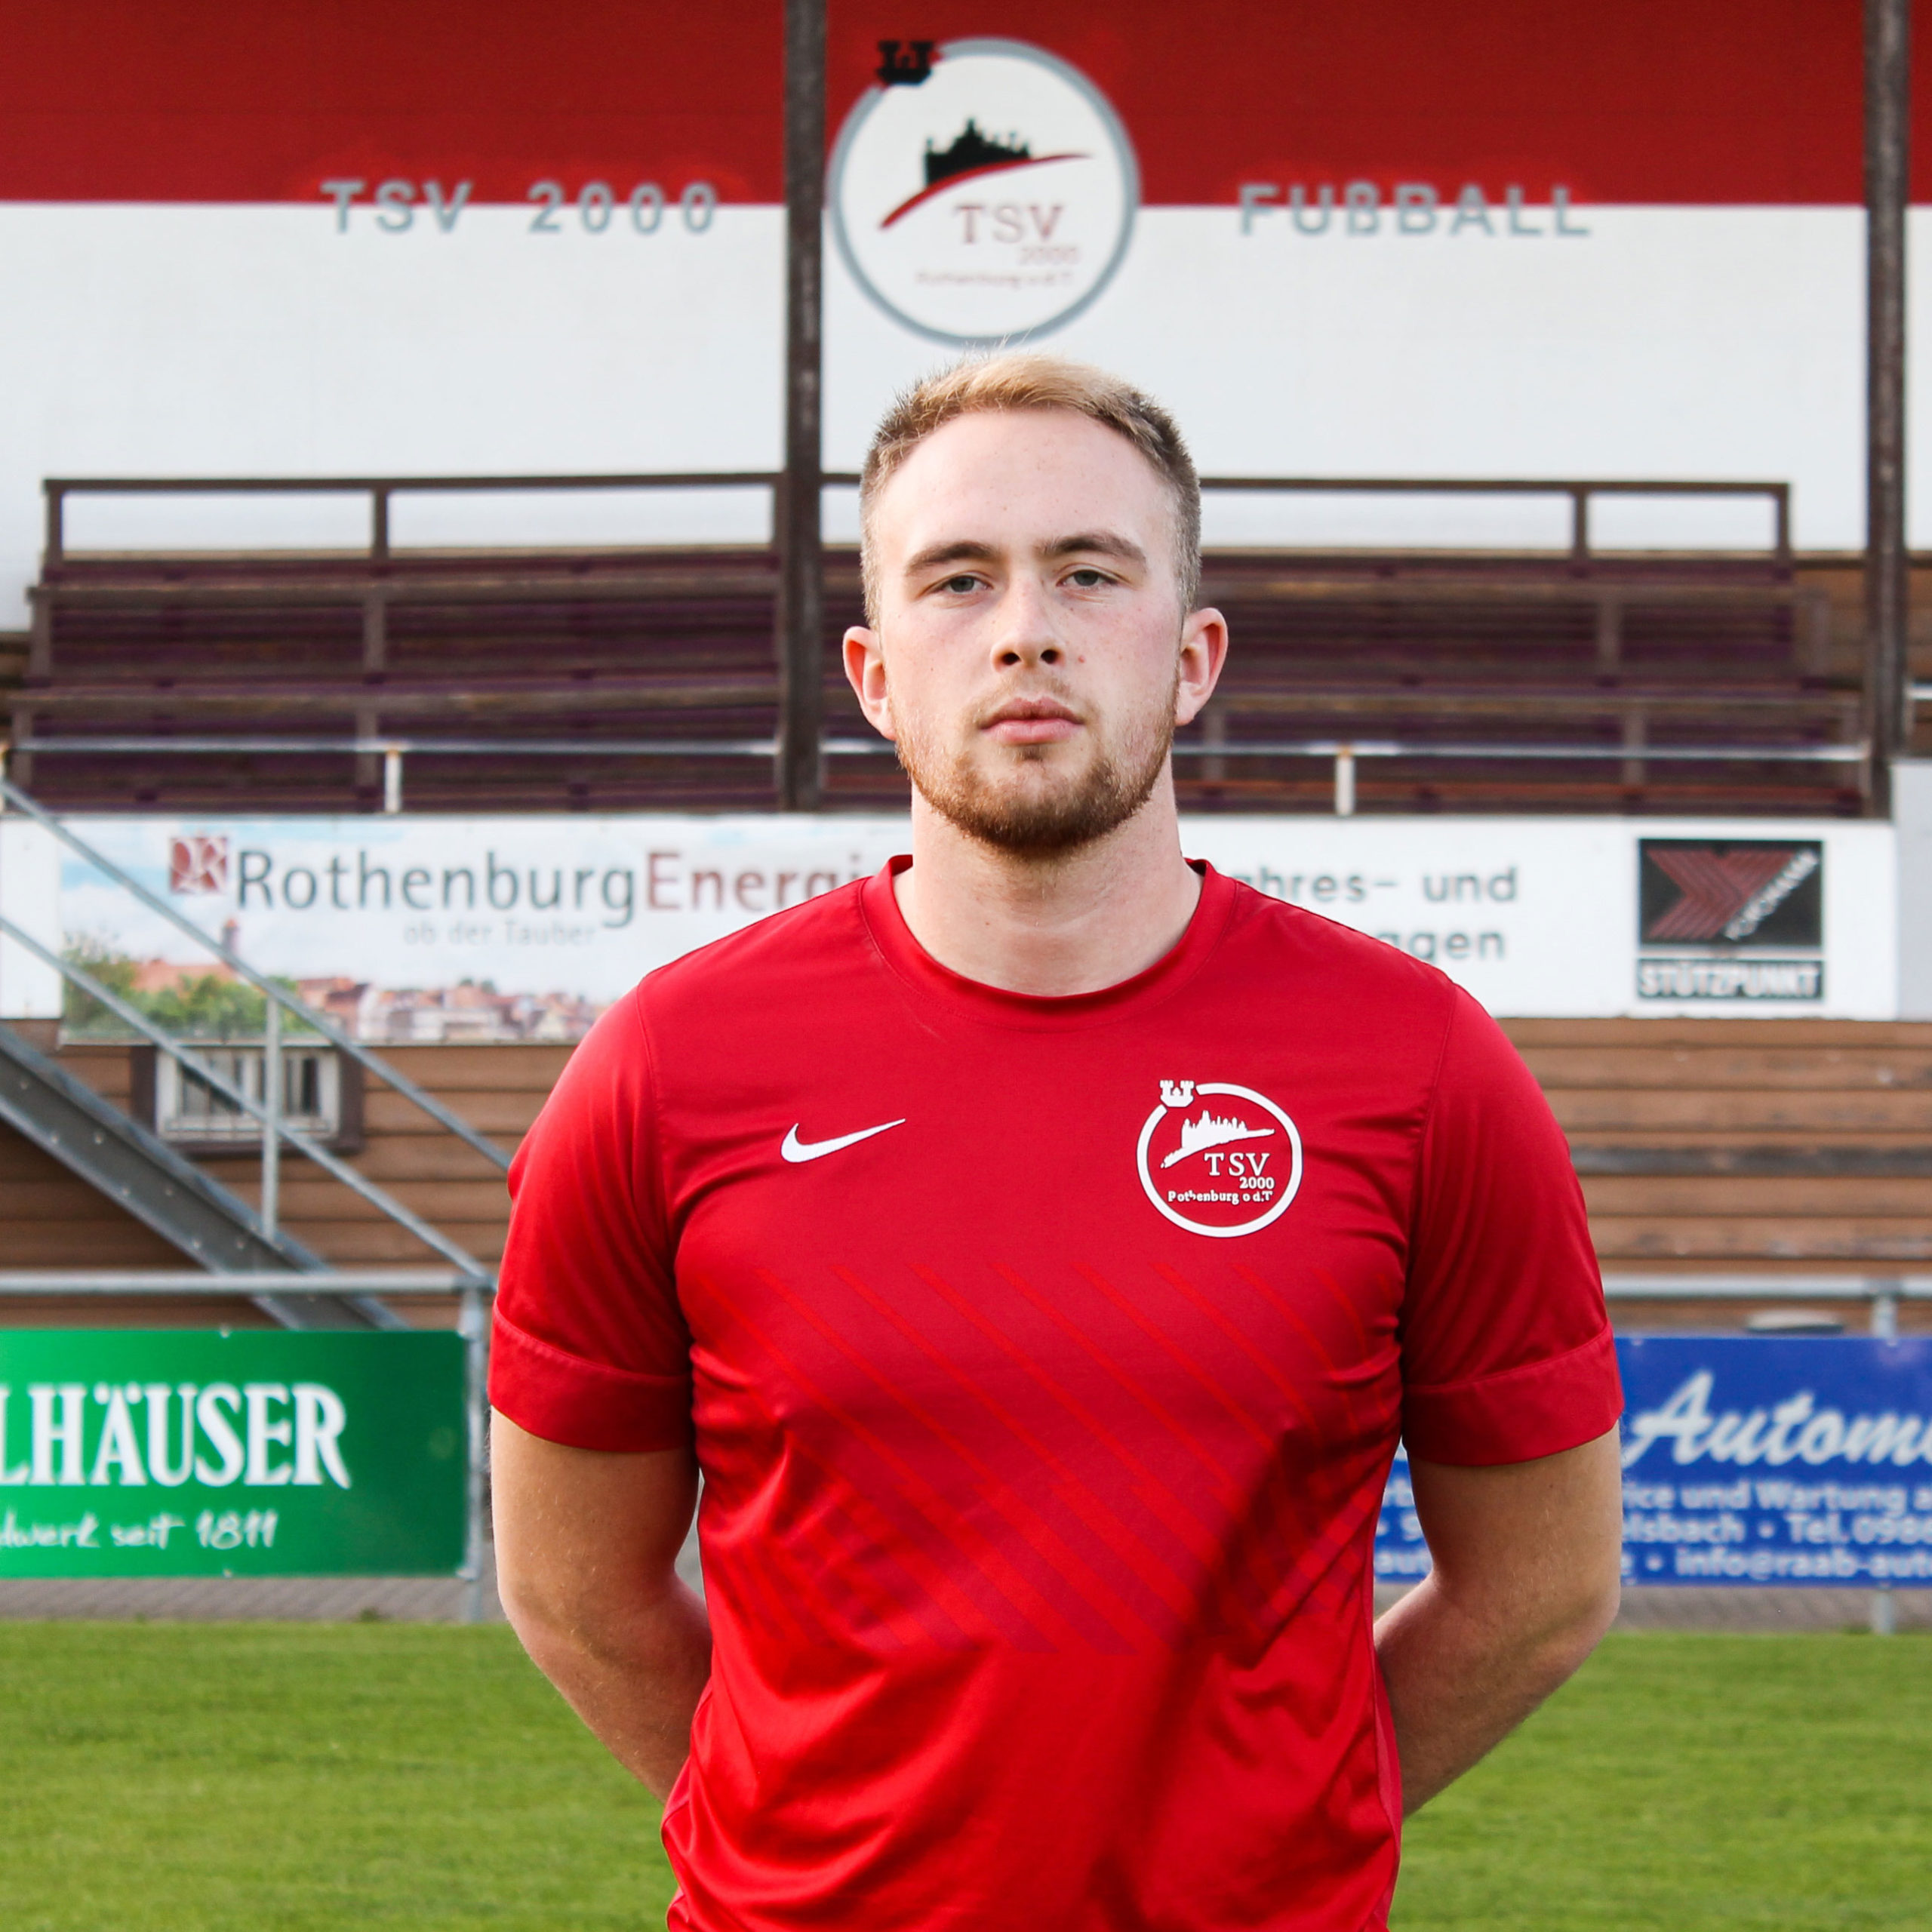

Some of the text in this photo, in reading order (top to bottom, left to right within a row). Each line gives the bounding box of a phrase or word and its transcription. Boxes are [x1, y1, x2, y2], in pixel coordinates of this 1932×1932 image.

[320, 180, 718, 235] TSV 2000
[954, 201, 1064, 245] TSV
[1423, 867, 1519, 903] und
[1639, 959, 1820, 996] STÜTZPUNKT
[1204, 1153, 1270, 1176] TSV
[1239, 1177, 1275, 1189] 2000
[1681, 1479, 1752, 1509] und
[1755, 1481, 1906, 1519] Wartung
[110, 1512, 186, 1549] seit
[195, 1509, 279, 1549] 1811
